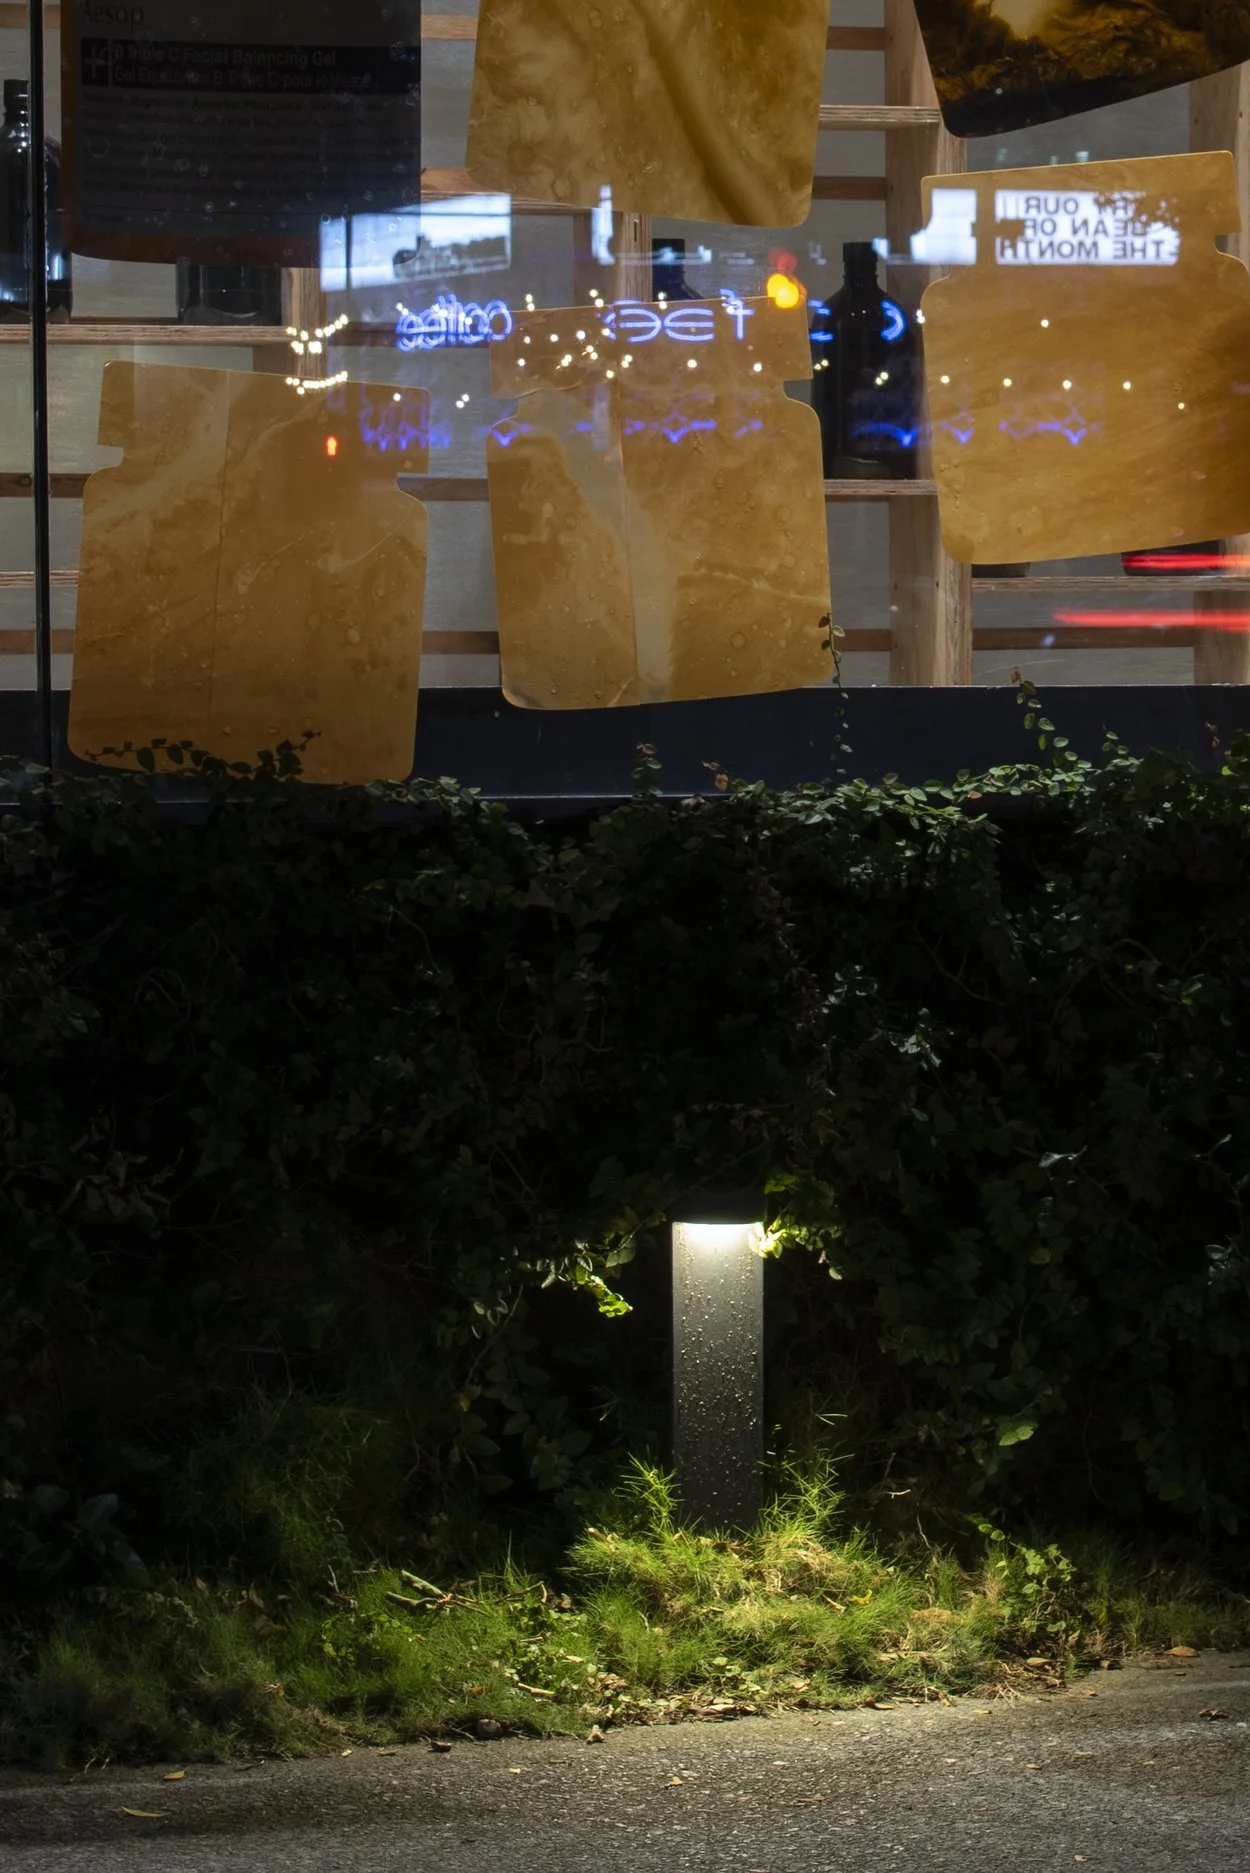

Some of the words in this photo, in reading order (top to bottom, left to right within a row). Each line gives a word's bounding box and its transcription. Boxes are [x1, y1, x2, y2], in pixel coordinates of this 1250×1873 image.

[169, 47, 180, 62] C
[183, 47, 228, 64] Facial
[232, 48, 309, 70] Balancing
[312, 49, 336, 67] Gel
[114, 65, 135, 82] Gel
[282, 73, 314, 93] pour
